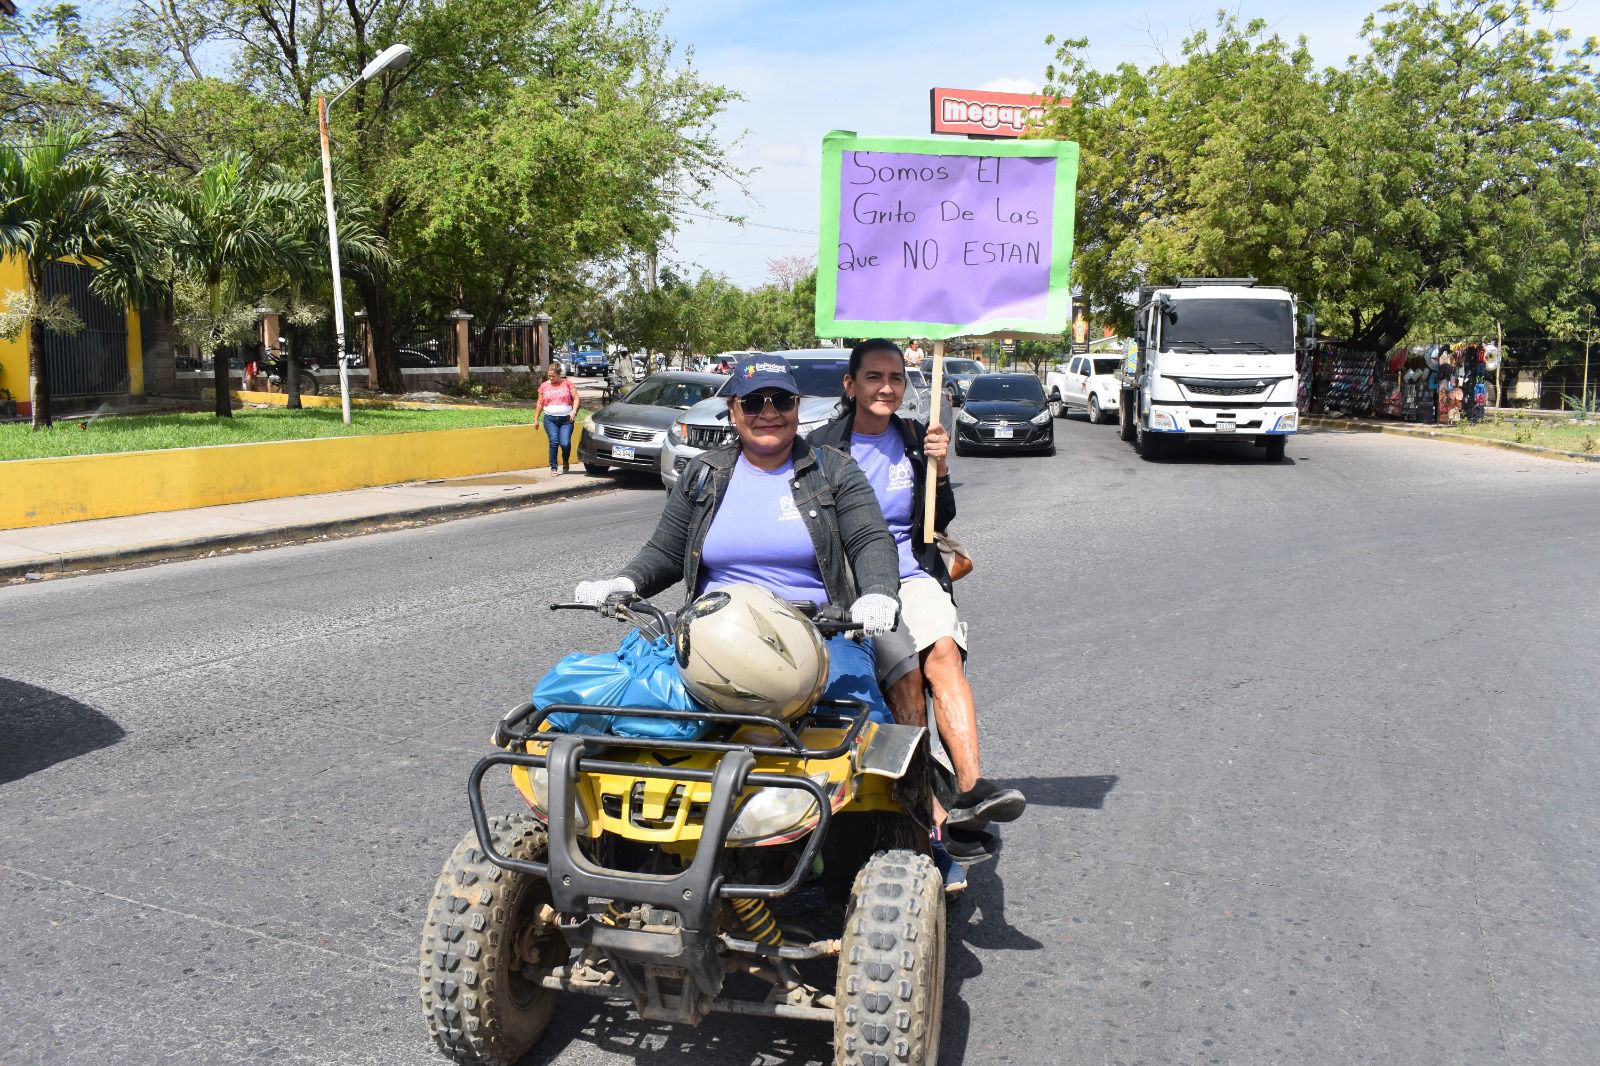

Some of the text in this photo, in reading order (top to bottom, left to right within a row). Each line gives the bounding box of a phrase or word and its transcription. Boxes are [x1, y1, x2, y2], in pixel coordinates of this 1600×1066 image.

[849, 151, 949, 185] Somos
[853, 192, 916, 224] Grito
[941, 200, 974, 221] De
[838, 239, 1040, 271] Que NO ESTAN
